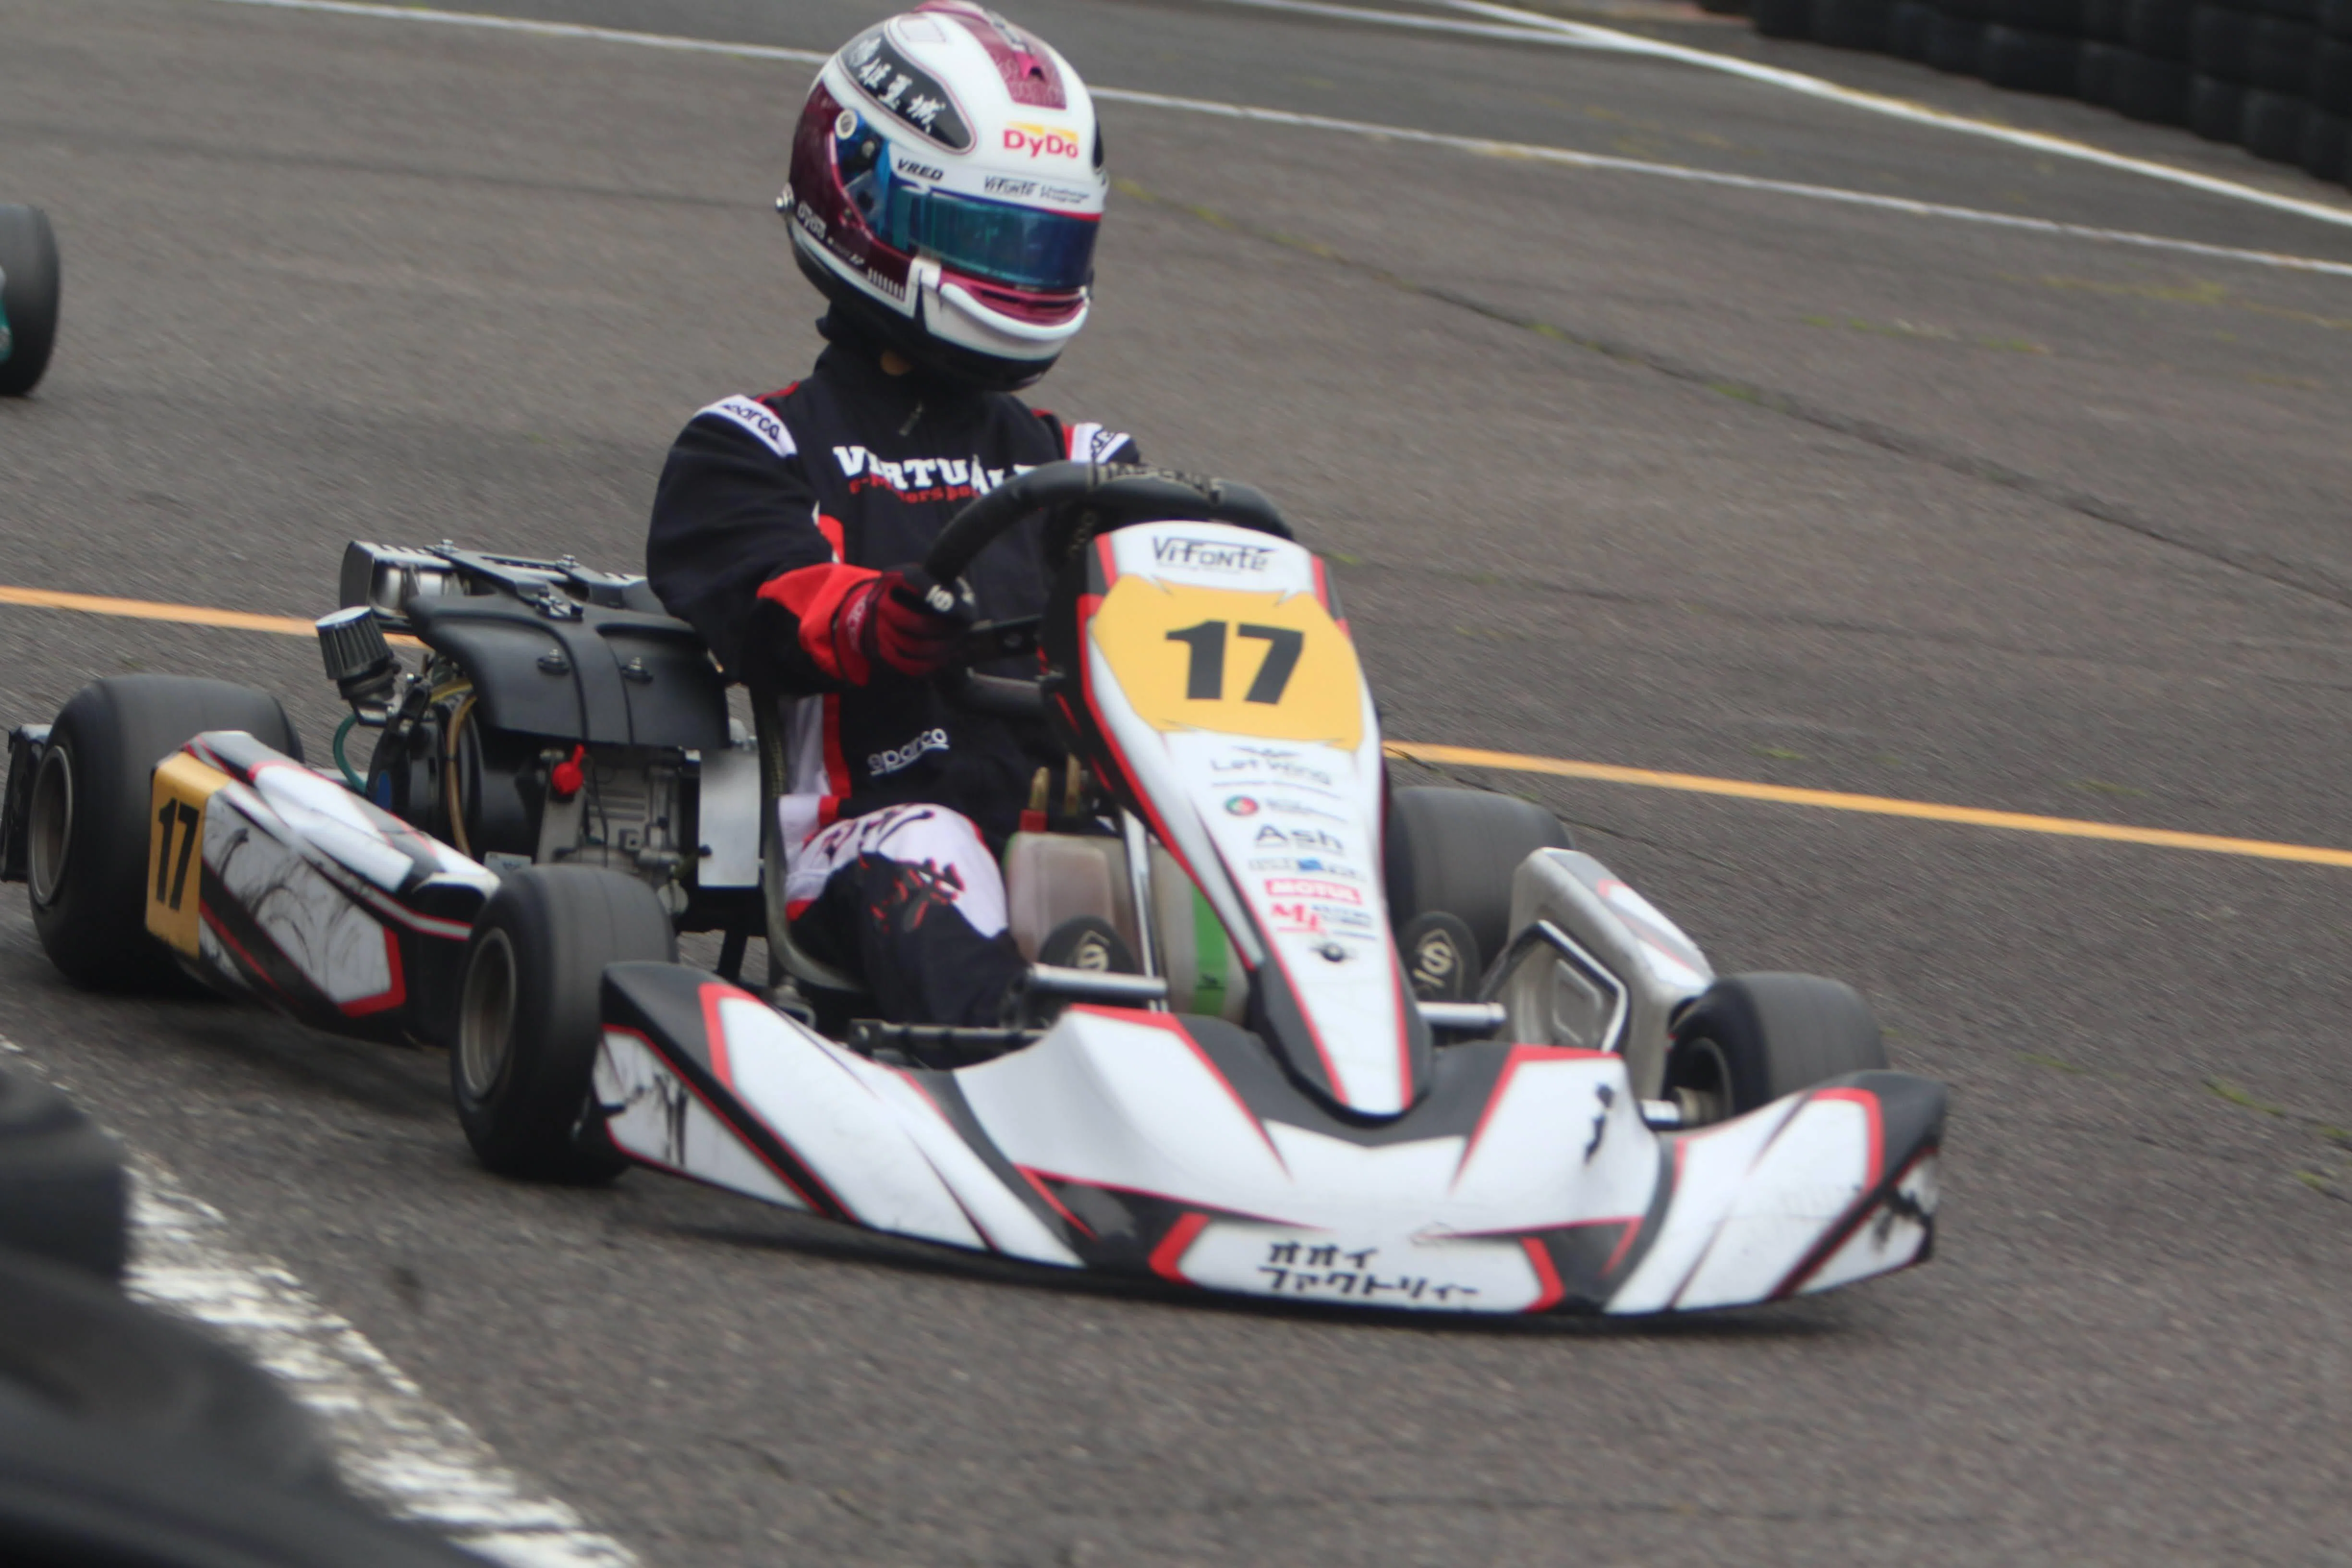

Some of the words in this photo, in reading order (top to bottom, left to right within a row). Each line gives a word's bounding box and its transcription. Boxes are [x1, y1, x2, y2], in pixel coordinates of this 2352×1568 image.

[1003, 129, 1079, 158] DyDo
[1165, 620, 1305, 705] 17
[867, 727, 950, 775] sparco
[158, 797, 200, 911] 17
[1255, 824, 1344, 850] Ash
